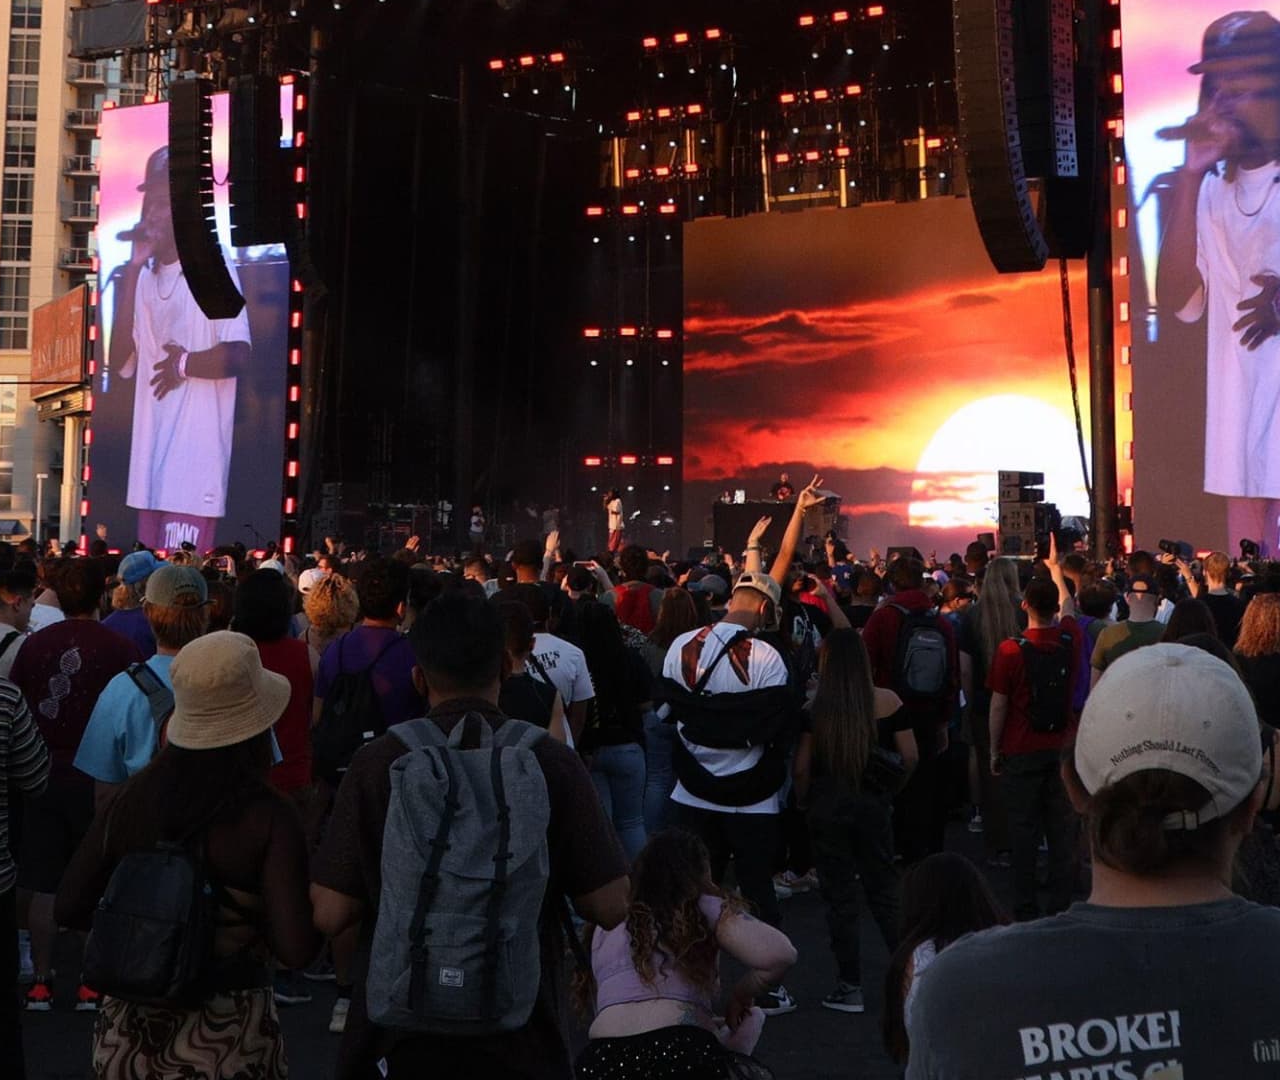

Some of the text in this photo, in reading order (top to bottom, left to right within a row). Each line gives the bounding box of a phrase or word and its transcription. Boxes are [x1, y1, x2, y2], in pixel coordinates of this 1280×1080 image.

[164, 522, 200, 549] TOMMY
[1110, 742, 1143, 767] Nothing
[1143, 739, 1175, 753] Should
[1176, 741, 1197, 756] Last
